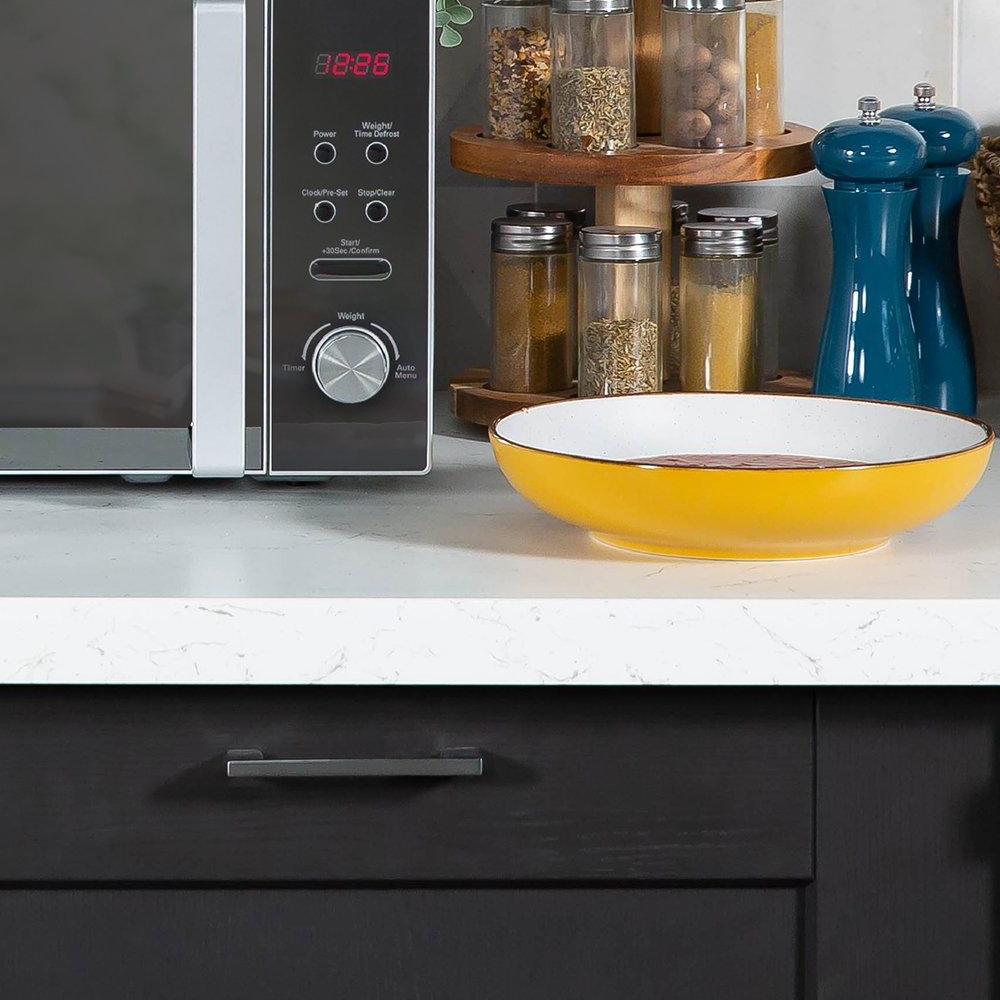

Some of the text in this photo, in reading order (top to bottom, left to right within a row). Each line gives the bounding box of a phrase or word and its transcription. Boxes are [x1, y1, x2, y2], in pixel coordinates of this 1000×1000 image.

[324, 53, 389, 75] 12:26
[361, 121, 393, 131] Weight/
[313, 130, 337, 138] Power
[354, 130, 400, 138] Time Defrost
[357, 189, 395, 198] Stop/Clear
[337, 312, 365, 321] Weight
[282, 364, 305, 372] Timer
[396, 364, 416, 372] Auto
[395, 372, 417, 380] Menu
